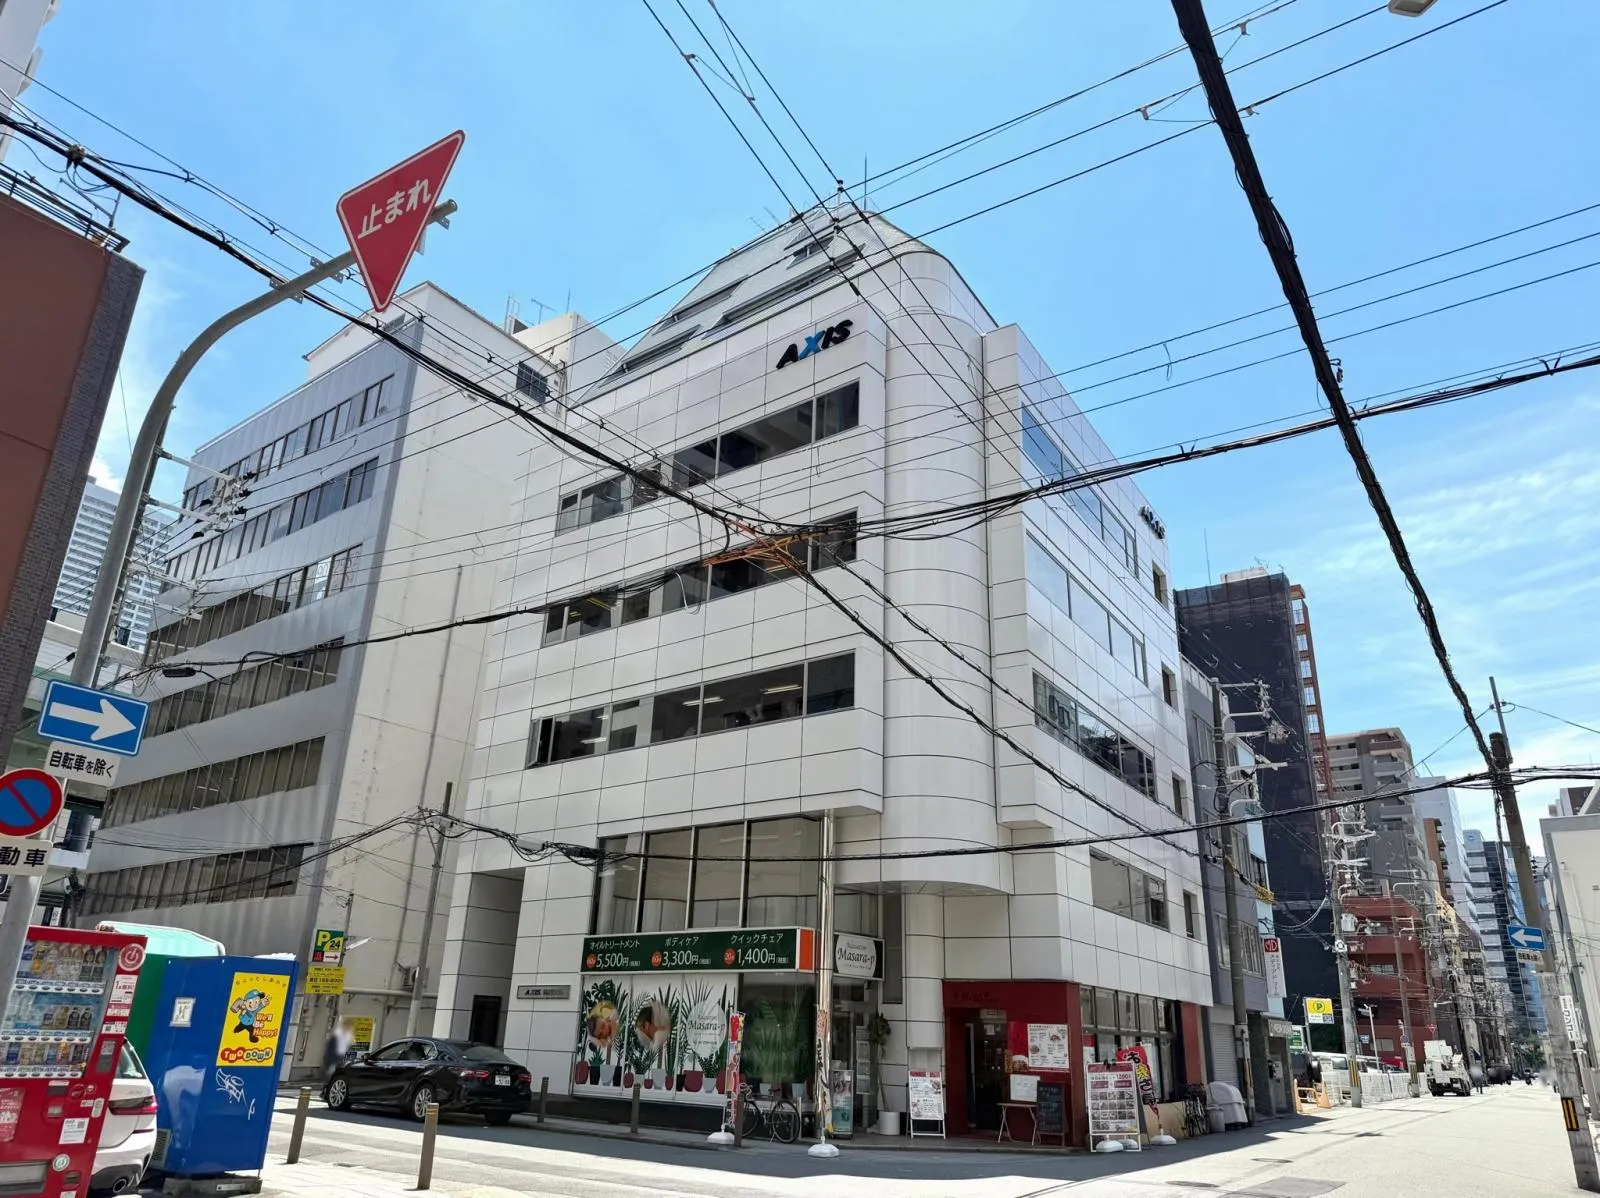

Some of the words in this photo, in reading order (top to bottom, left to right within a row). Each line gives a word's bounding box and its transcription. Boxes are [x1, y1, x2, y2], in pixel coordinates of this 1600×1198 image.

[357, 178, 432, 240] 止まれ
[775, 319, 854, 370] AXIS
[49, 749, 115, 778] 自転車を除く
[329, 940, 341, 949] 24
[589, 939, 641, 950] オイルトリートメント
[664, 936, 699, 947] ボディケア
[731, 933, 784, 945] クイックチェア
[837, 947, 875, 970] Masara-p
[256, 1013, 273, 1022] We'll
[254, 1021, 265, 1029] Be
[253, 1029, 278, 1038] Happy!
[223, 1048, 244, 1061] TWO
[244, 1048, 272, 1061] DOWN
